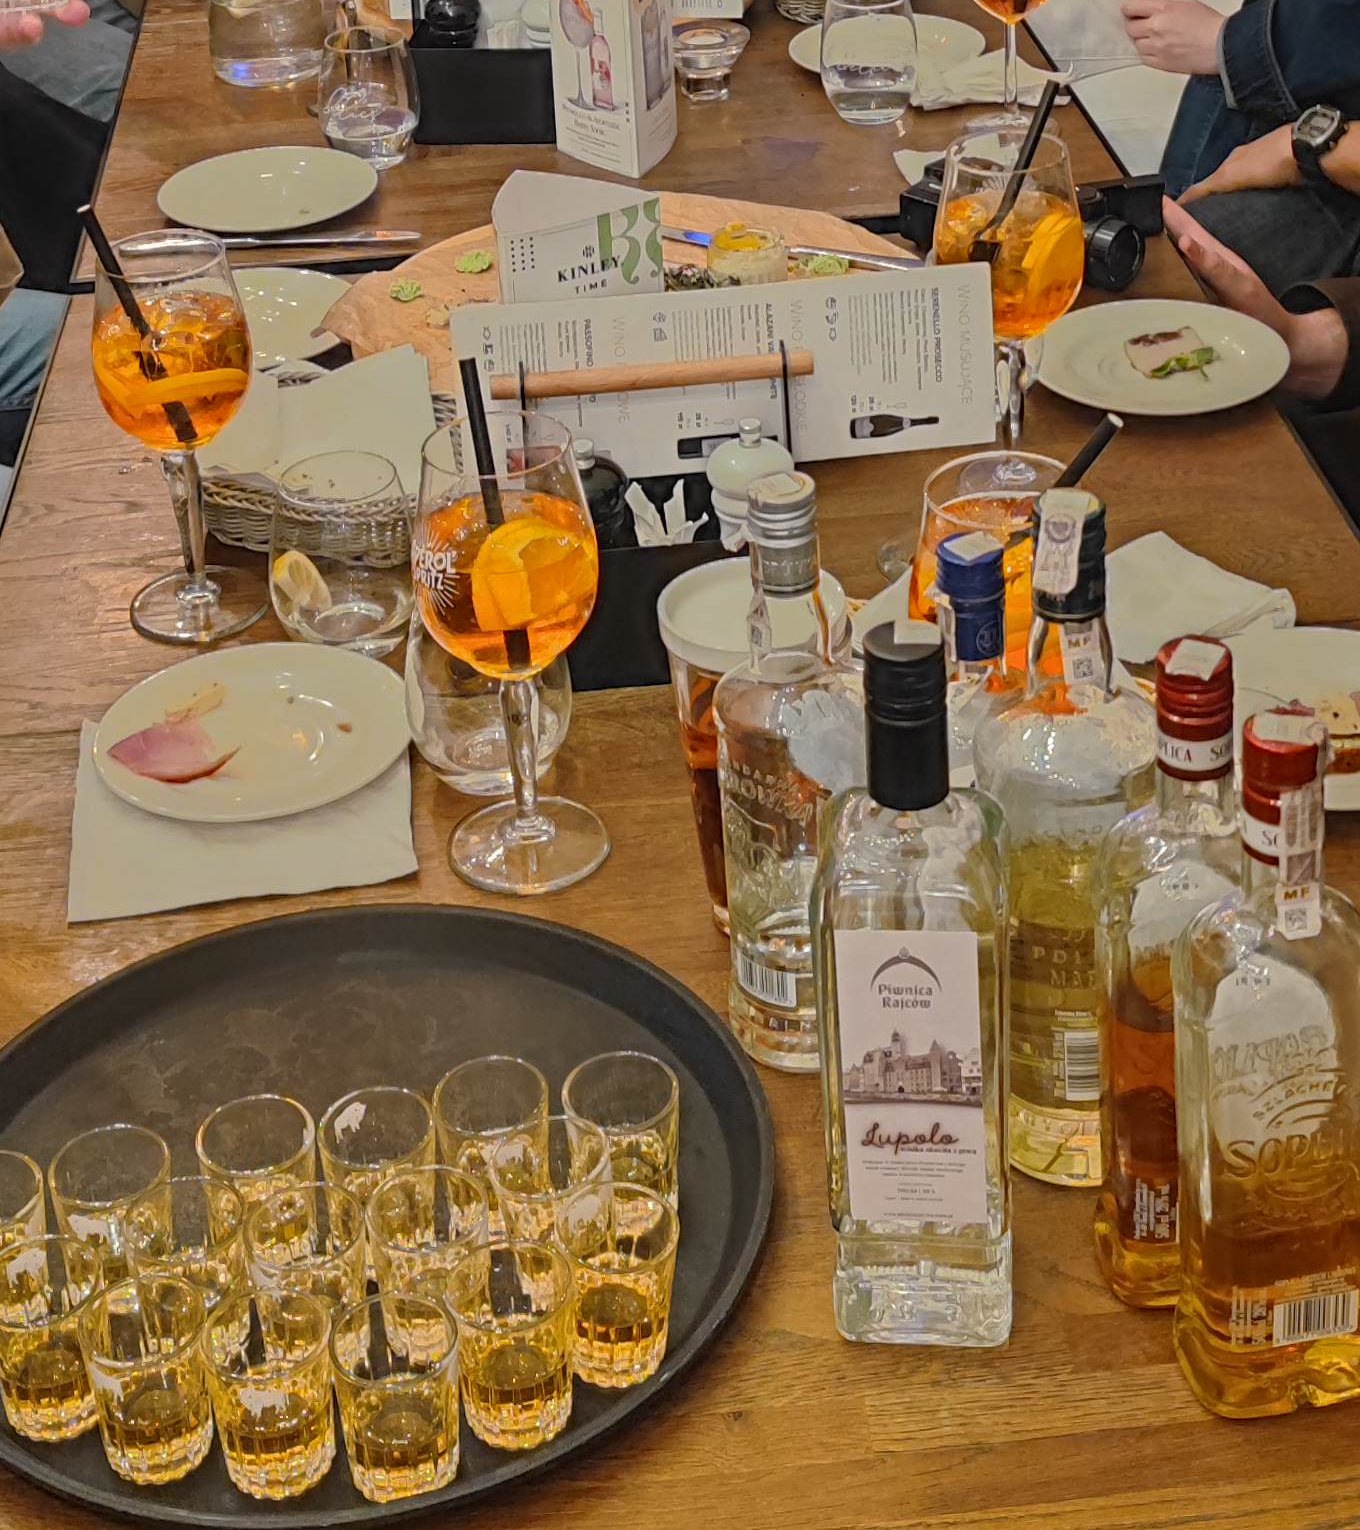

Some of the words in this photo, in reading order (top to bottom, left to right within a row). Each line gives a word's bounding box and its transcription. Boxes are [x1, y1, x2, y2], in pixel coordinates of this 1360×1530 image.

[558, 255, 621, 283] KINLEY
[575, 278, 608, 294] TIME
[790, 299, 804, 342] WINO
[583, 318, 594, 368] PASSOFINO
[413, 568, 444, 590] PRITZ
[1284, 887, 1311, 901] MF
[878, 983, 934, 998] Piwnica
[882, 996, 932, 1010] Rajców
[861, 1122, 960, 1156] Lupolo
